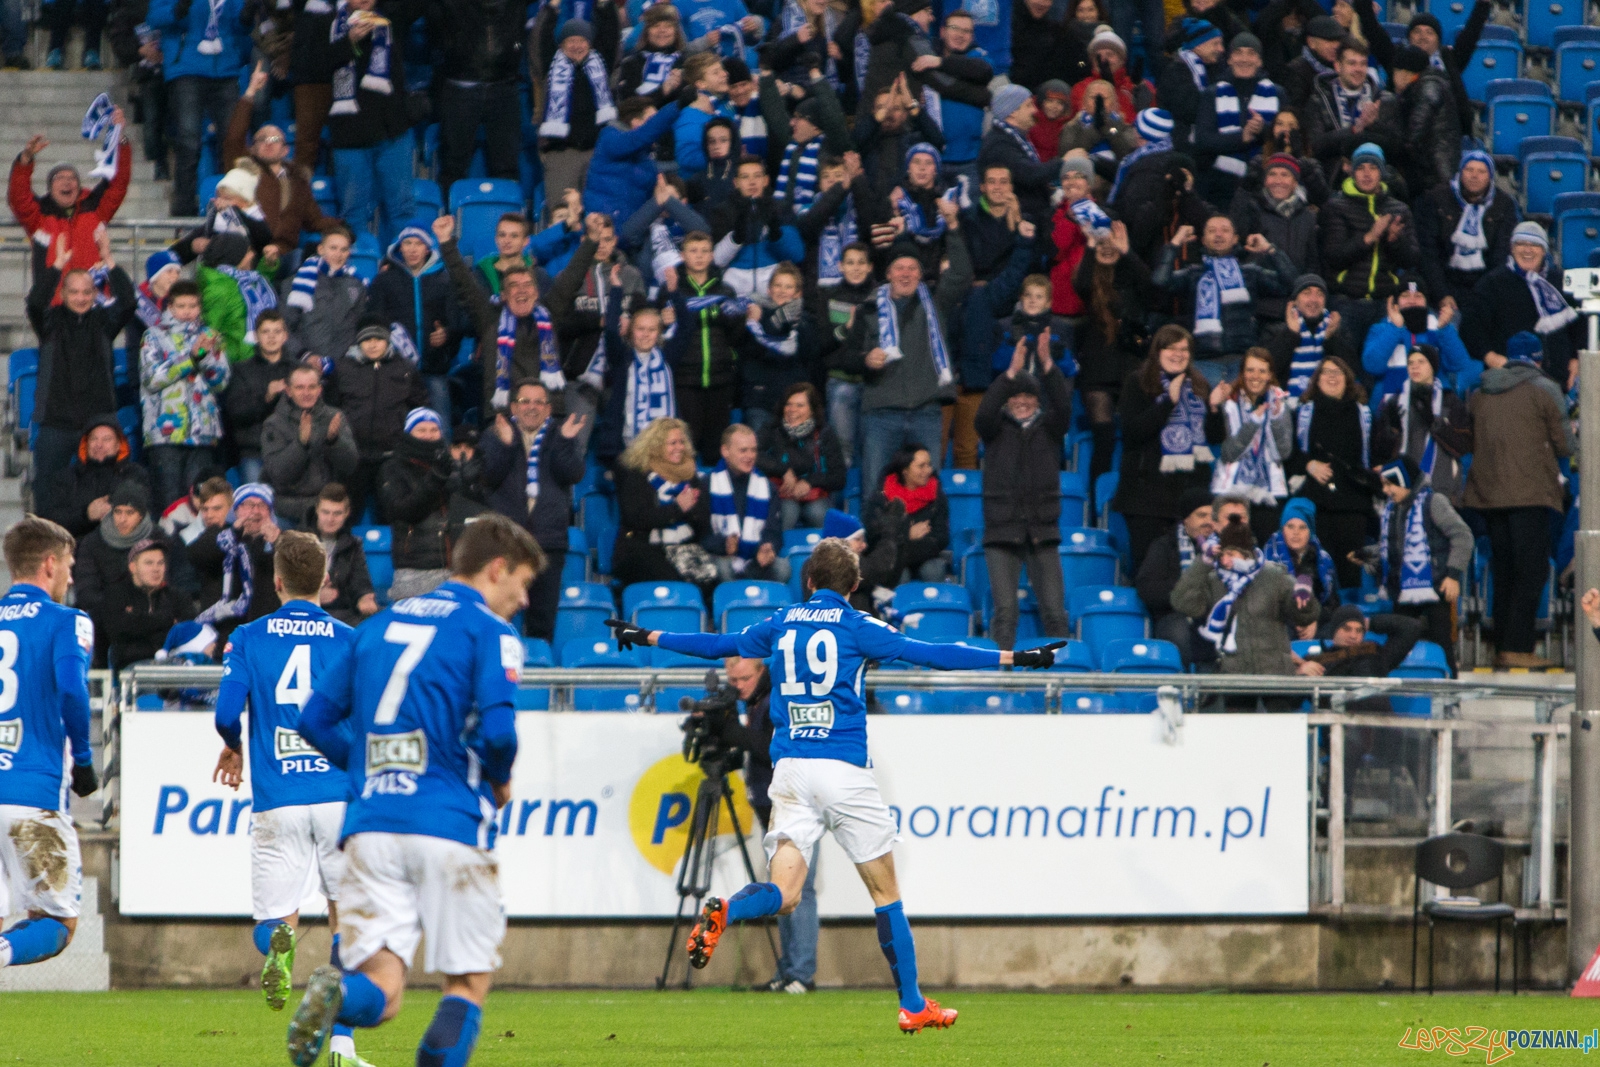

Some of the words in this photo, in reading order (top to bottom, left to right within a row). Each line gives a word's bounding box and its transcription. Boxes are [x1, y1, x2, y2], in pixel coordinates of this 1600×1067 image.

[0, 601, 42, 622] UGLAS
[267, 618, 334, 638] KĘDZIORA
[373, 621, 438, 725] 7
[777, 629, 838, 696] 19
[275, 644, 313, 714] 4
[792, 708, 829, 722] LECH
[279, 734, 318, 750] LEC
[789, 728, 830, 740] PILS
[370, 739, 419, 763] LECH
[281, 757, 330, 775] PILS
[361, 772, 418, 799] PILS
[500, 799, 599, 836] irm
